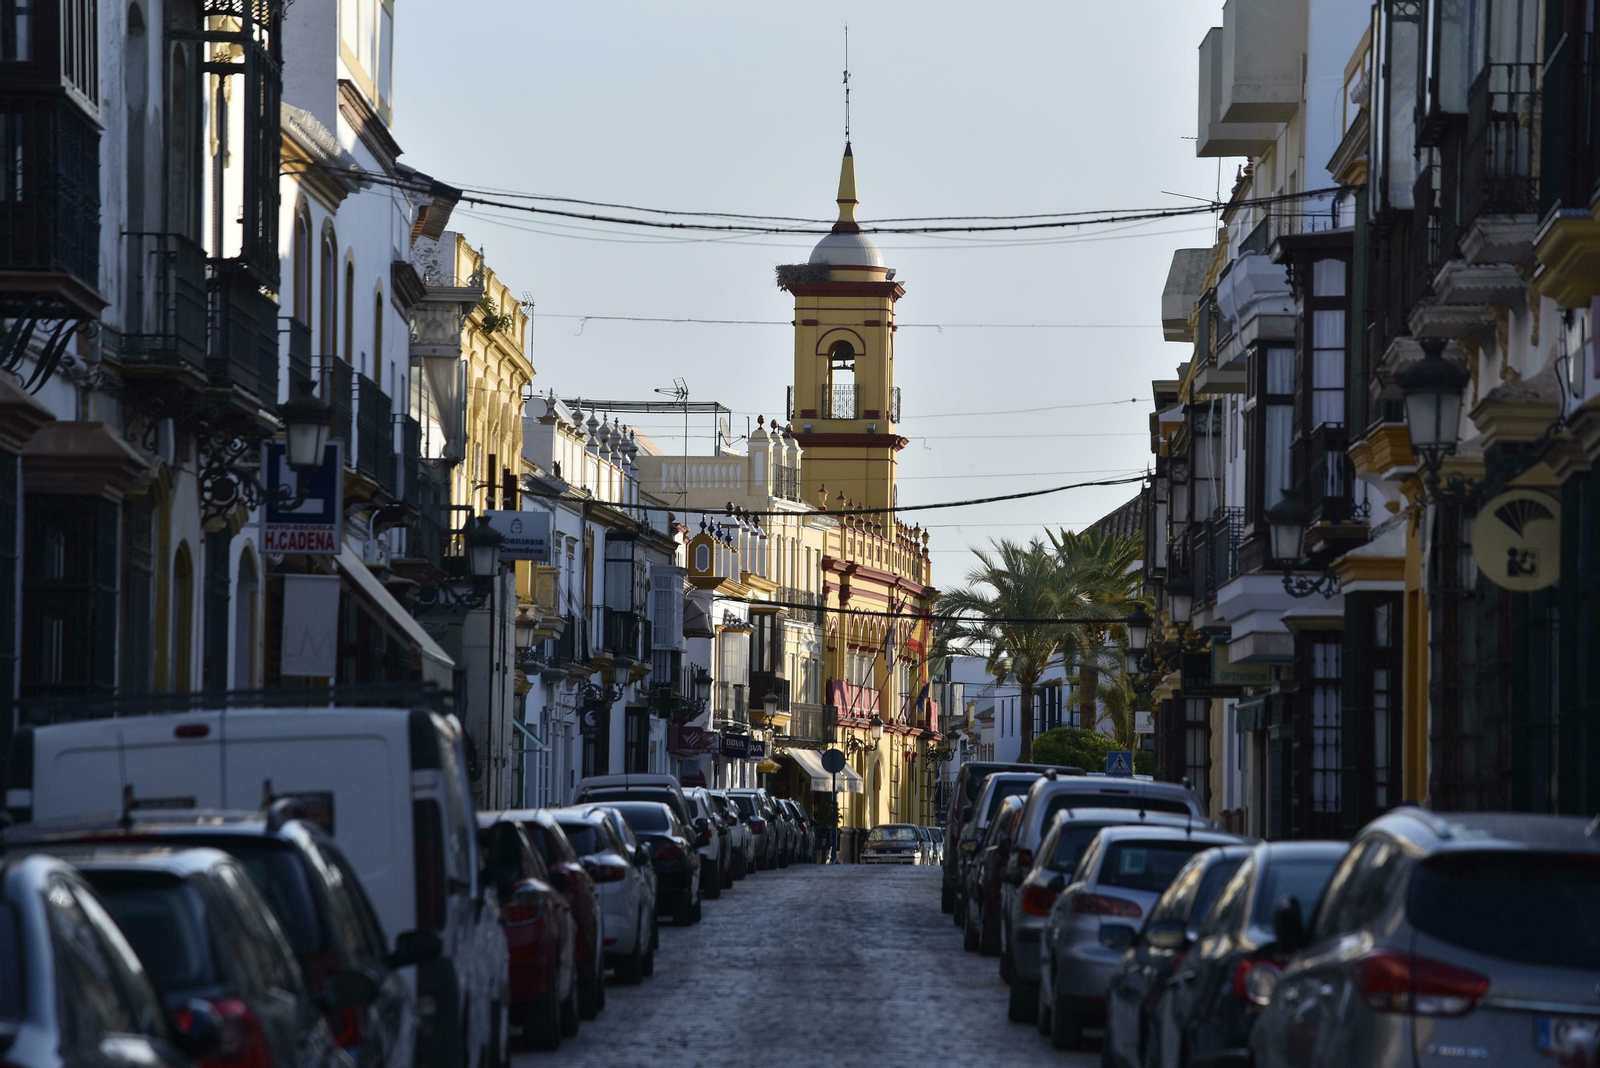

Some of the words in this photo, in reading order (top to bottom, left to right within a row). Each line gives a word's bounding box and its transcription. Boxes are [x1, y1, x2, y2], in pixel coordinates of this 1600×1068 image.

[264, 531, 336, 551] H.CADENA
[502, 537, 544, 546] OBILIARIA
[499, 545, 544, 555] Corredera
[1220, 671, 1268, 681] OPTIVISION
[726, 738, 745, 748] BBVA
